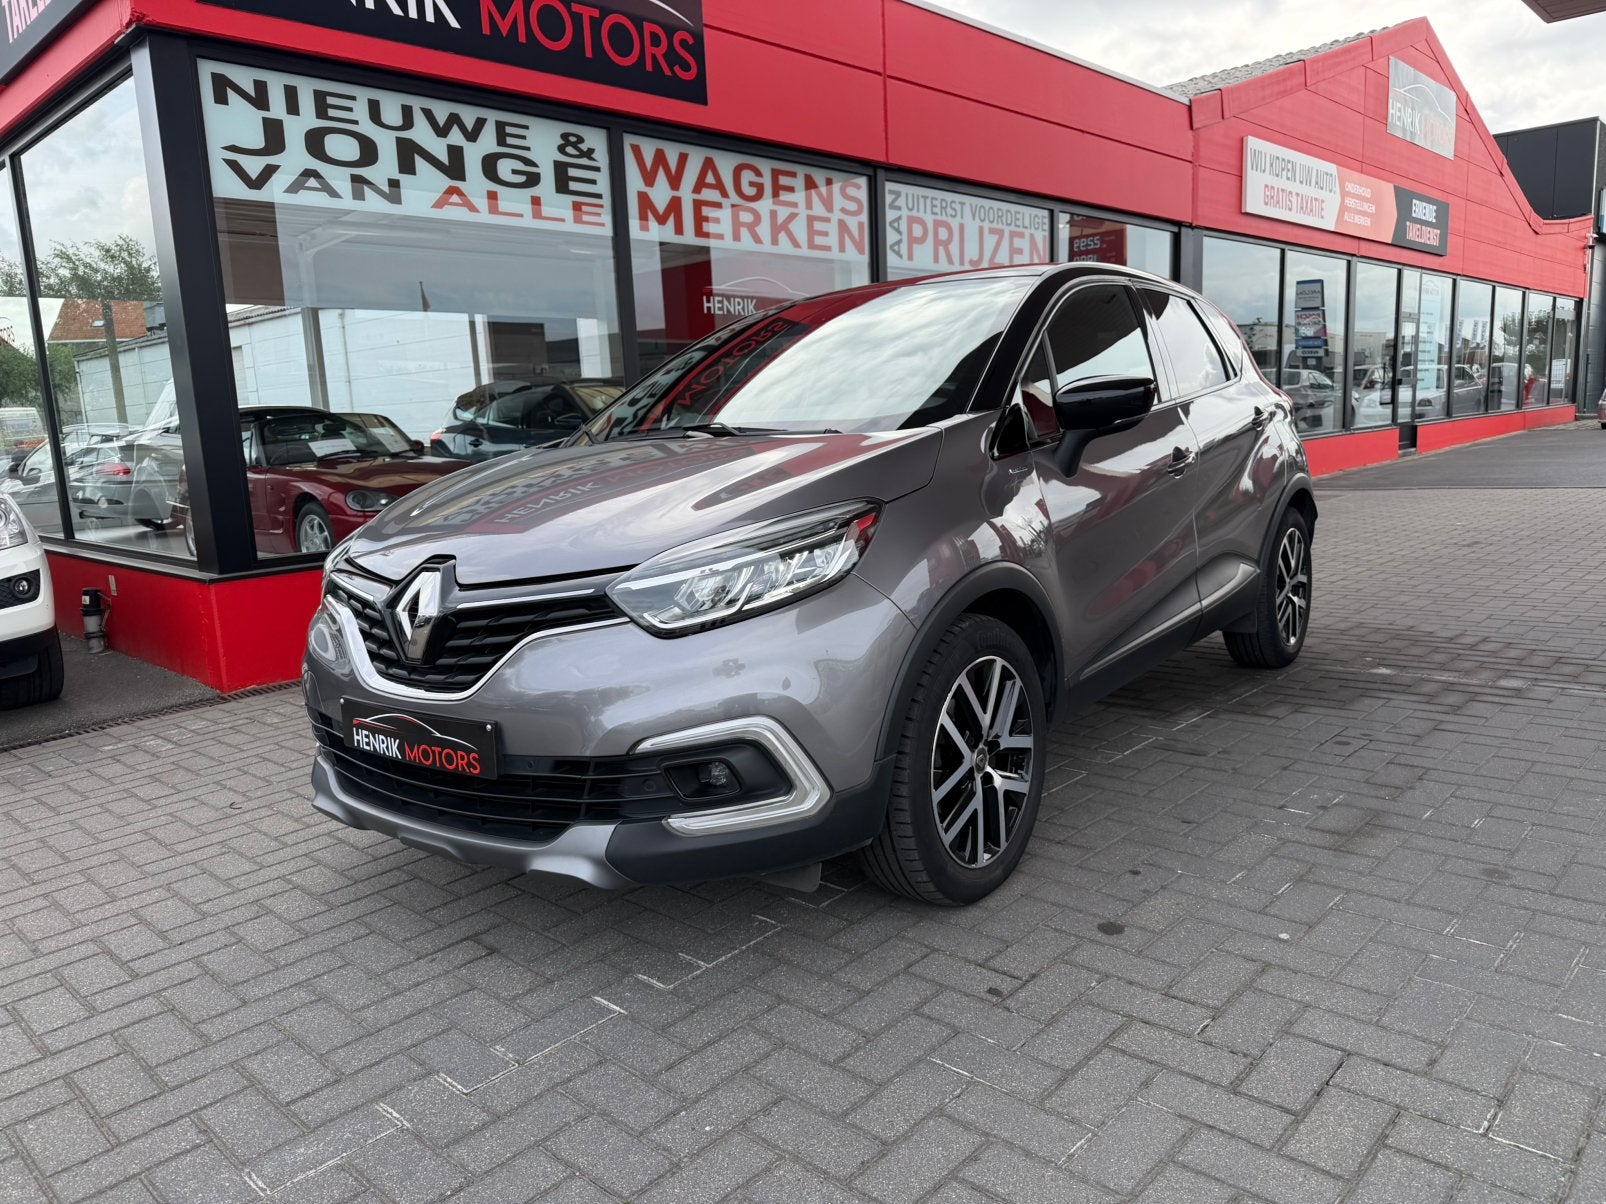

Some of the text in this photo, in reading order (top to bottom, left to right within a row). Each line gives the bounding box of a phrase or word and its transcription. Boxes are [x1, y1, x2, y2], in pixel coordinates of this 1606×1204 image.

[479, 0, 698, 81] MOTORS
[210, 72, 599, 162] NIEUWE &
[1389, 99, 1421, 135] HENRIK
[220, 116, 603, 200] JONGE
[629, 143, 865, 217] WAGENS
[1249, 147, 1337, 195] WIJ KOPEN UW AUTO!
[221, 157, 606, 228] VAN ALLE
[905, 192, 1048, 232] UITERST VOORDELIGE
[1263, 183, 1325, 219] GRATIS TAXATIE
[1411, 199, 1437, 223] ERKENDE
[636, 190, 866, 256] MERKEN
[887, 189, 903, 260] AAN
[906, 215, 1048, 269] PRIJZEN
[1405, 221, 1441, 247] TAKELDIENST
[703, 296, 756, 315] HENRIK
[353, 727, 481, 774] HENRIK MOTORS
